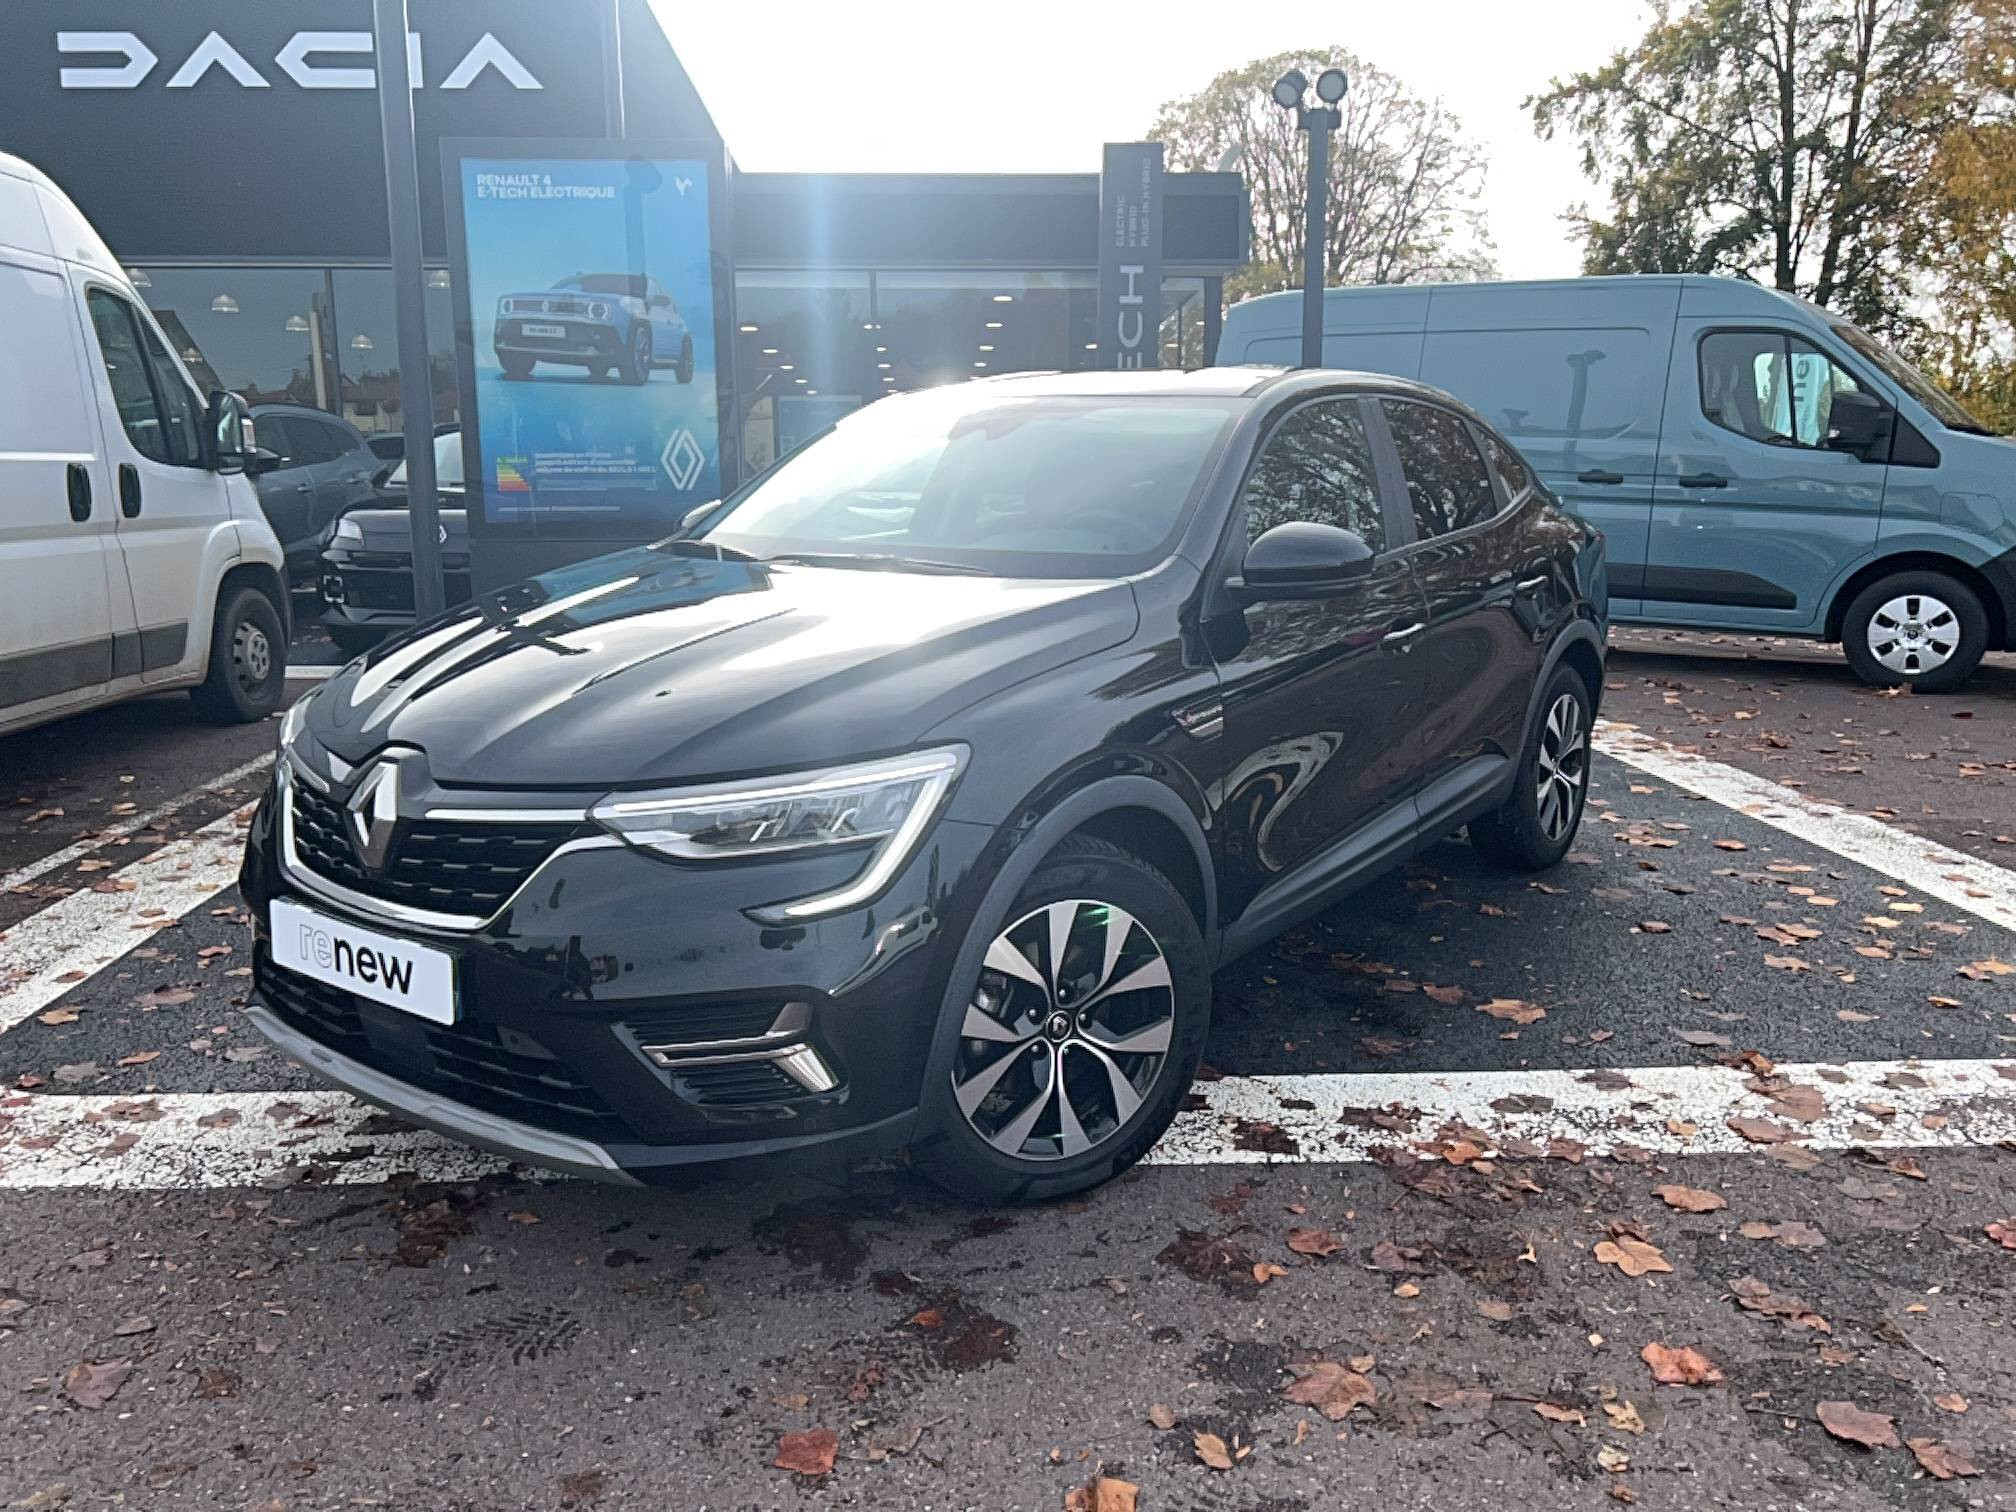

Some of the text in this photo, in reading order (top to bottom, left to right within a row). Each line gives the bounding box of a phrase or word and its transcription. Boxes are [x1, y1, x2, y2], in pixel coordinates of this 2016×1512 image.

[57, 30, 544, 90] DACIA
[477, 174, 551, 187] RENAULT 4
[477, 186, 528, 199] E-TECH
[1141, 157, 1152, 199] HYBRID
[1116, 194, 1126, 248] ELECTRIC
[1129, 205, 1138, 248] HYBRID
[298, 923, 414, 995] renew
